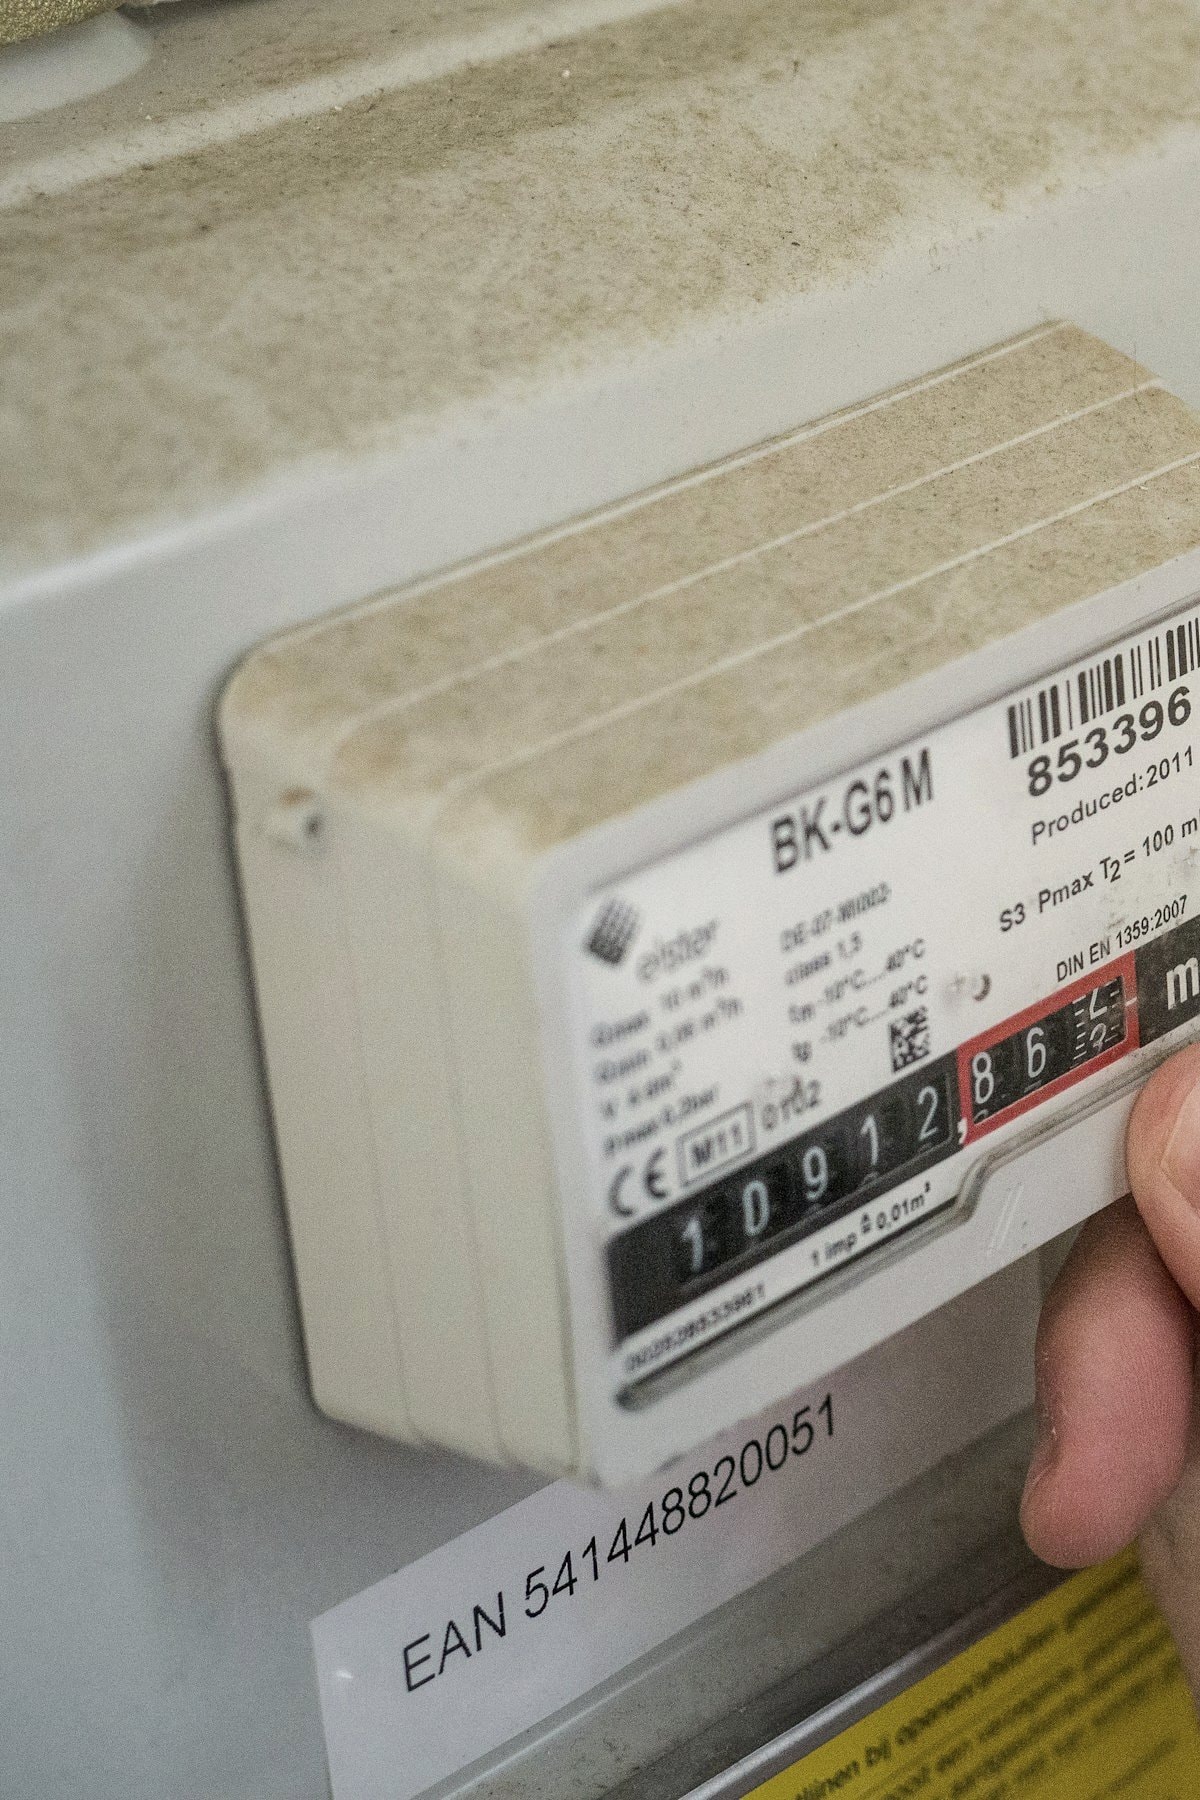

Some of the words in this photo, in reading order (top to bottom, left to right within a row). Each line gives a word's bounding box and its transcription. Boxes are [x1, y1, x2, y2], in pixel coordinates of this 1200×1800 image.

[1028, 686, 1191, 797] 853396
[1000, 902, 1026, 932] S3
[1038, 871, 1094, 914] Pmax
[1142, 824, 1174, 857] 100
[1057, 952, 1085, 983] DIN
[1089, 937, 1112, 965] EN
[1116, 894, 1188, 949] 1359:2007
[402, 1591, 507, 1693] EAN
[524, 1393, 836, 1618] 541448820051
